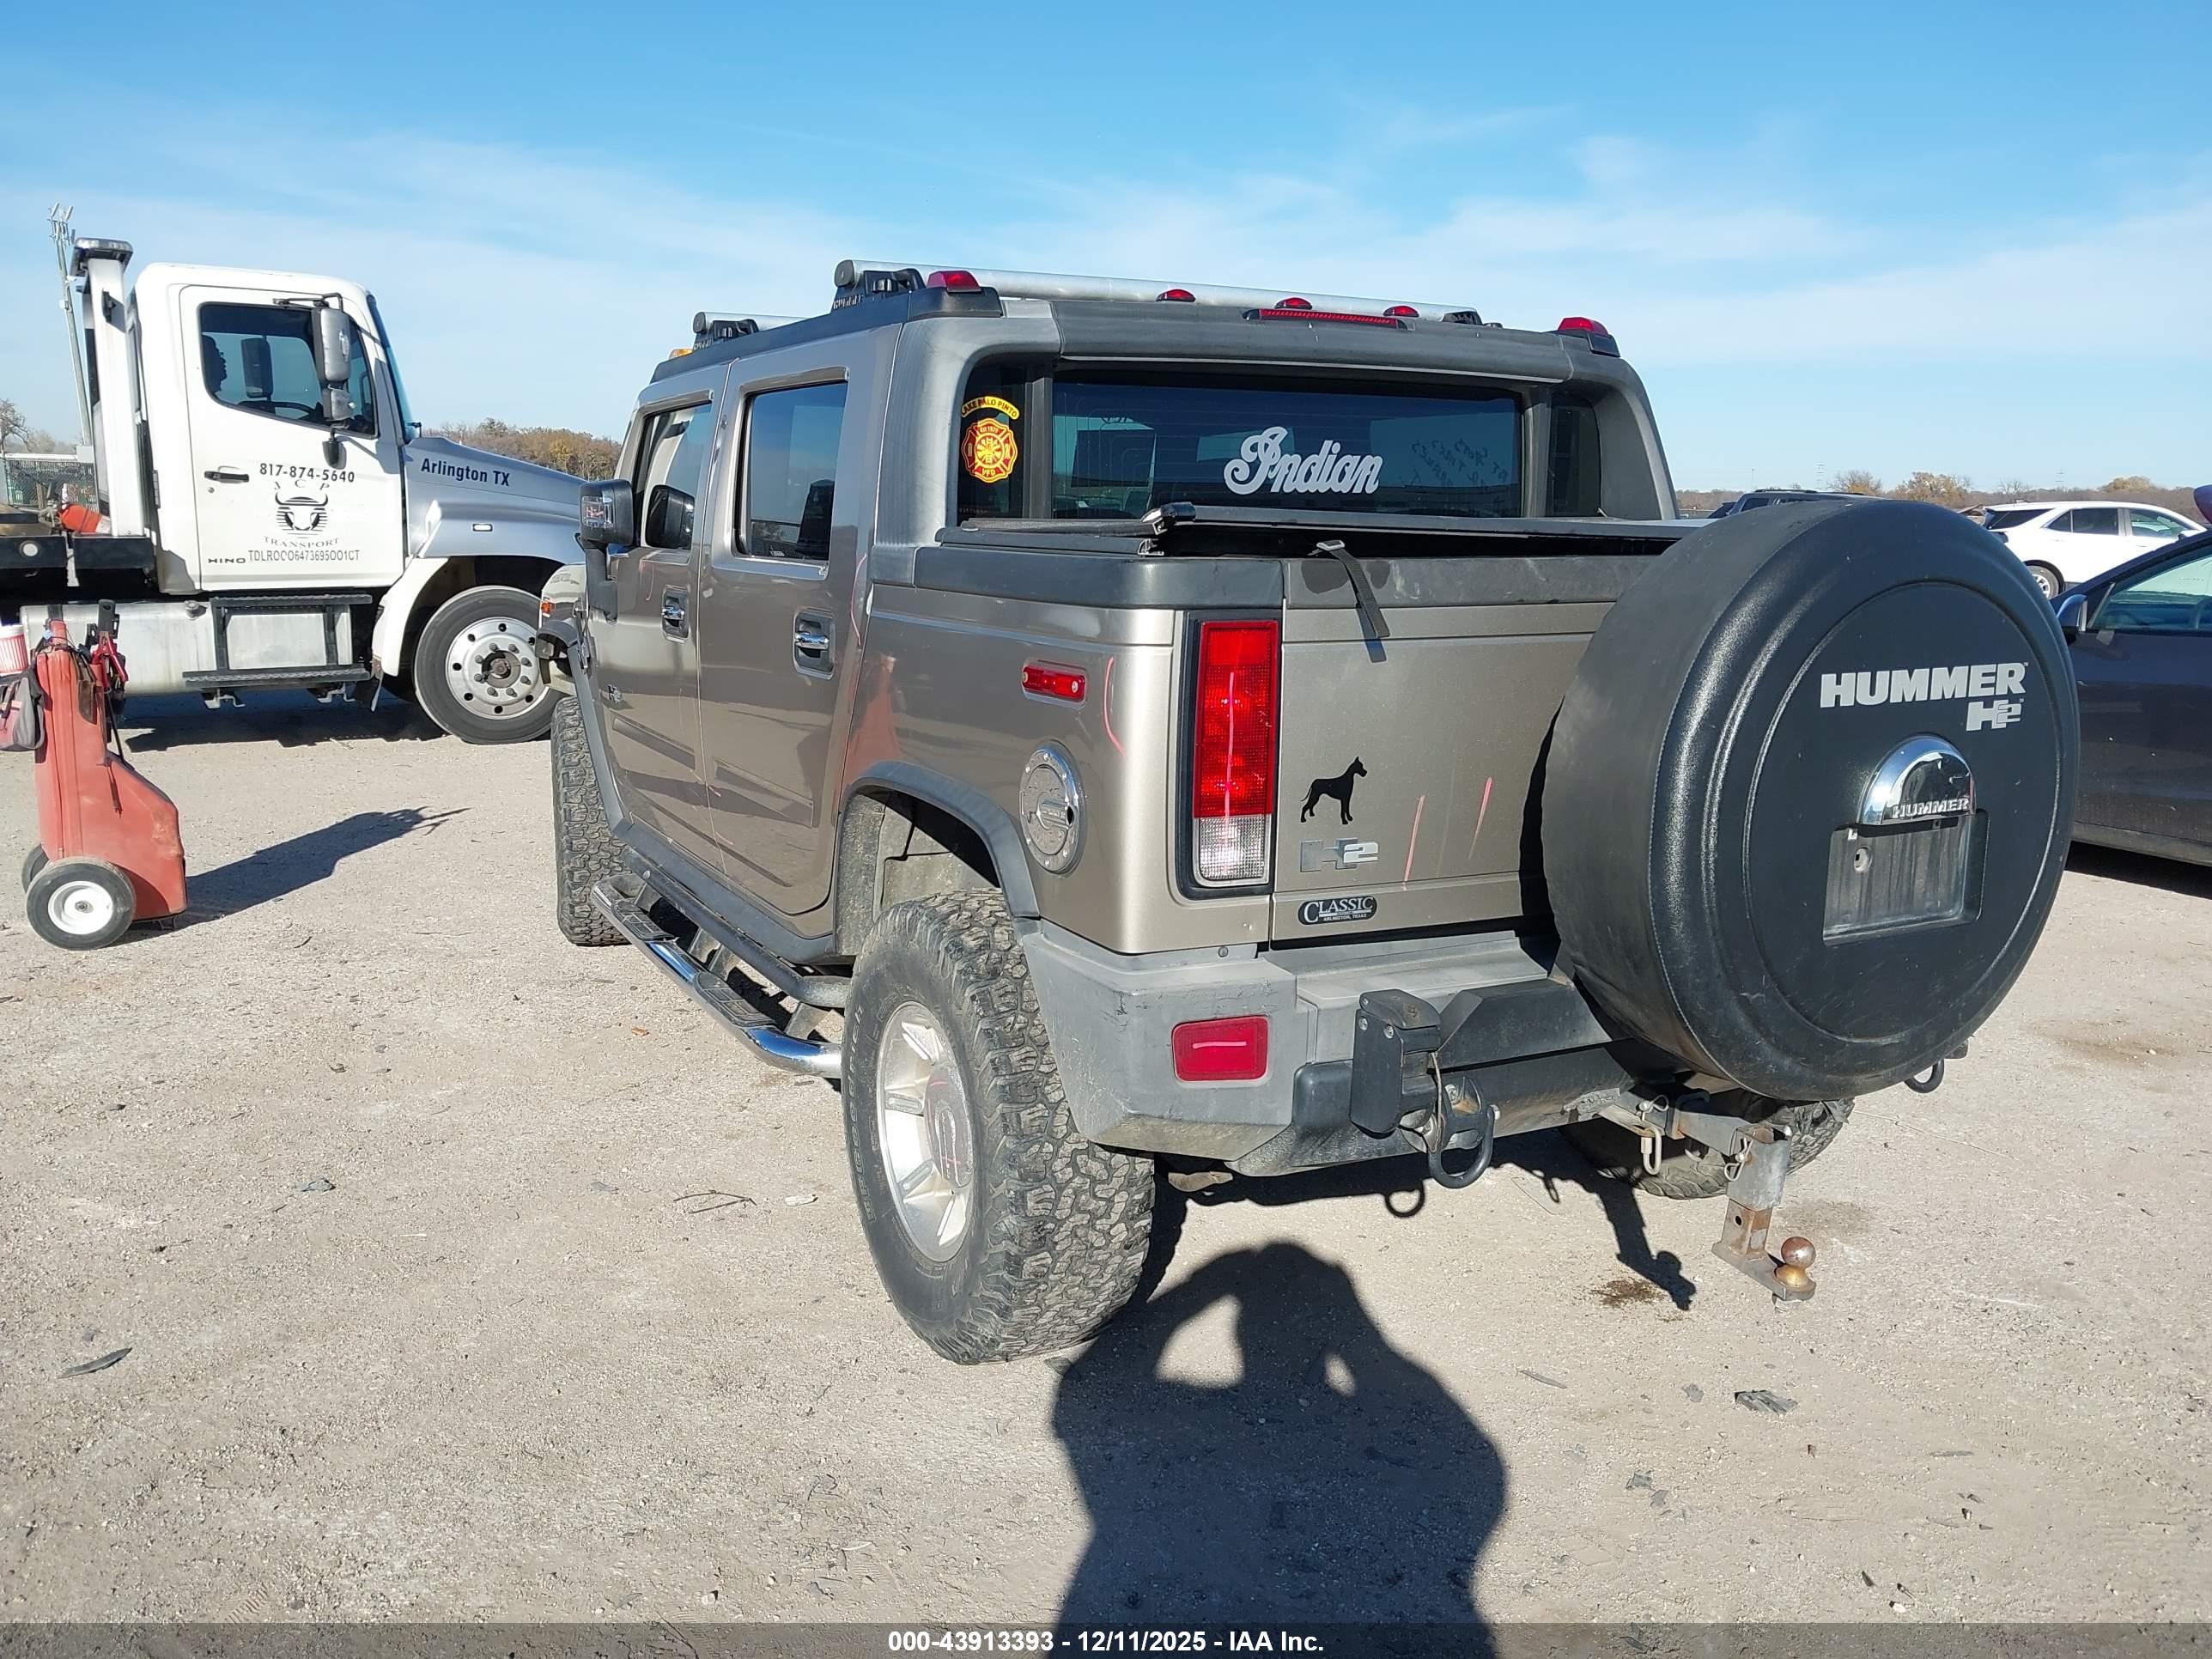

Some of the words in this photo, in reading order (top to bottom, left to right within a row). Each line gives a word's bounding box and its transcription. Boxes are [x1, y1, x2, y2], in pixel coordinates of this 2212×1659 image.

[998, 400, 1018, 417] PINTO
[259, 463, 355, 483] 817-874-5640
[421, 458, 488, 483] Arlington
[493, 470, 510, 487] TX
[1224, 426, 1383, 495] Indian
[264, 536, 338, 548] TRANSPORT
[1820, 662, 2027, 708] HUMMER
[1966, 699, 2022, 732] H2
[1892, 798, 1969, 819] HUMMER
[1304, 896, 1373, 923] CLASSIC
